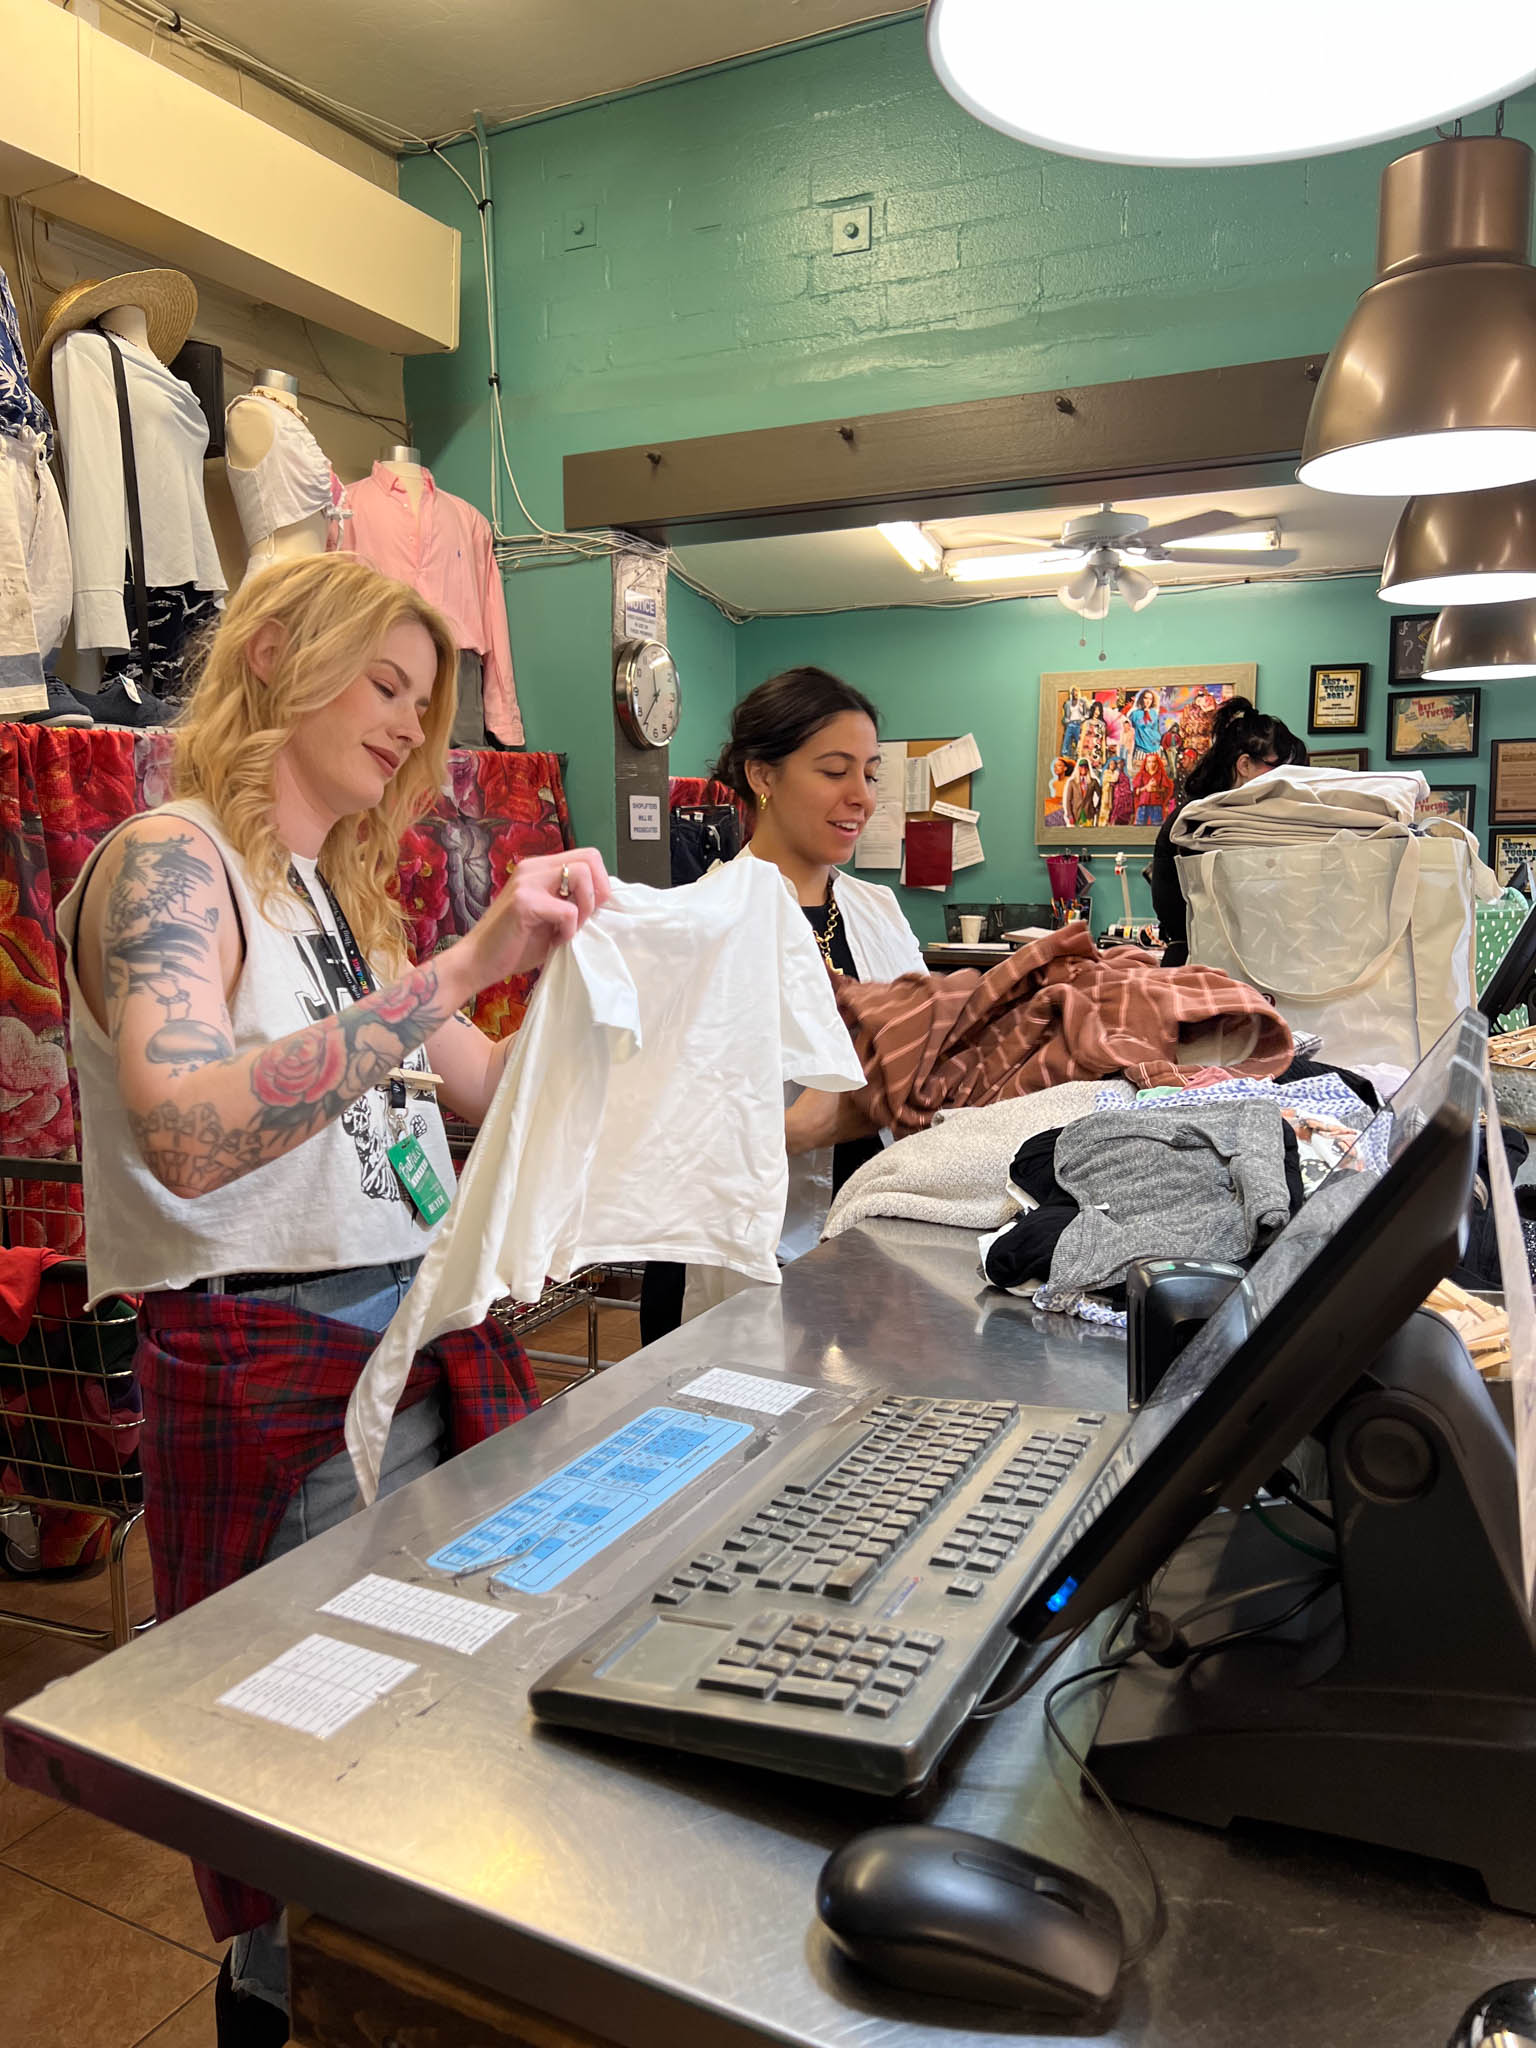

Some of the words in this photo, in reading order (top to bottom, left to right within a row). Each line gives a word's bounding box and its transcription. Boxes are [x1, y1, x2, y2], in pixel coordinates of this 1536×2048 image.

[633, 686, 639, 696] 9
[638, 706, 643, 717] 8
[653, 728, 659, 738] 6
[662, 724, 667, 734] 5
[352, 957, 370, 995] EXCHANGE
